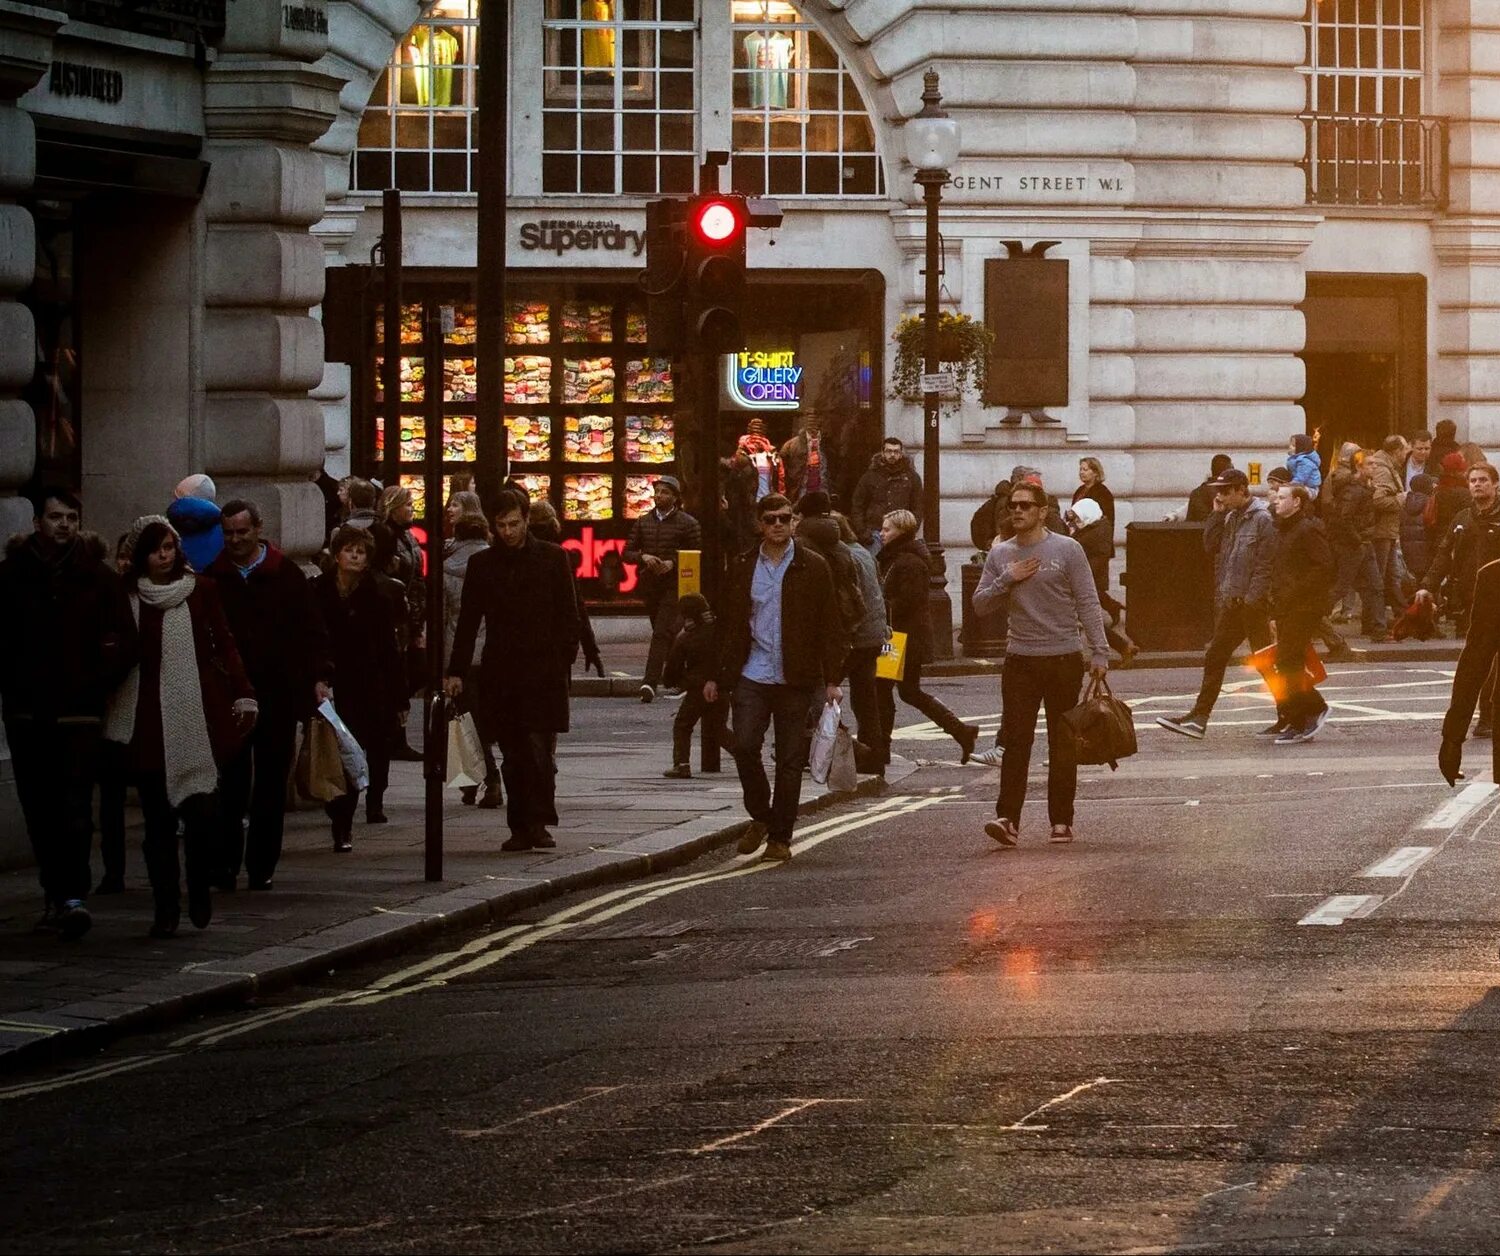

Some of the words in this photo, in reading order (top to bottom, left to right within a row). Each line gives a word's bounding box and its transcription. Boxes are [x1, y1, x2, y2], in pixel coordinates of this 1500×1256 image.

[1019, 177, 1086, 191] STREET
[520, 222, 647, 257] Superdry
[739, 351, 795, 368] T-SHIRT
[743, 367, 802, 384] GALLERY
